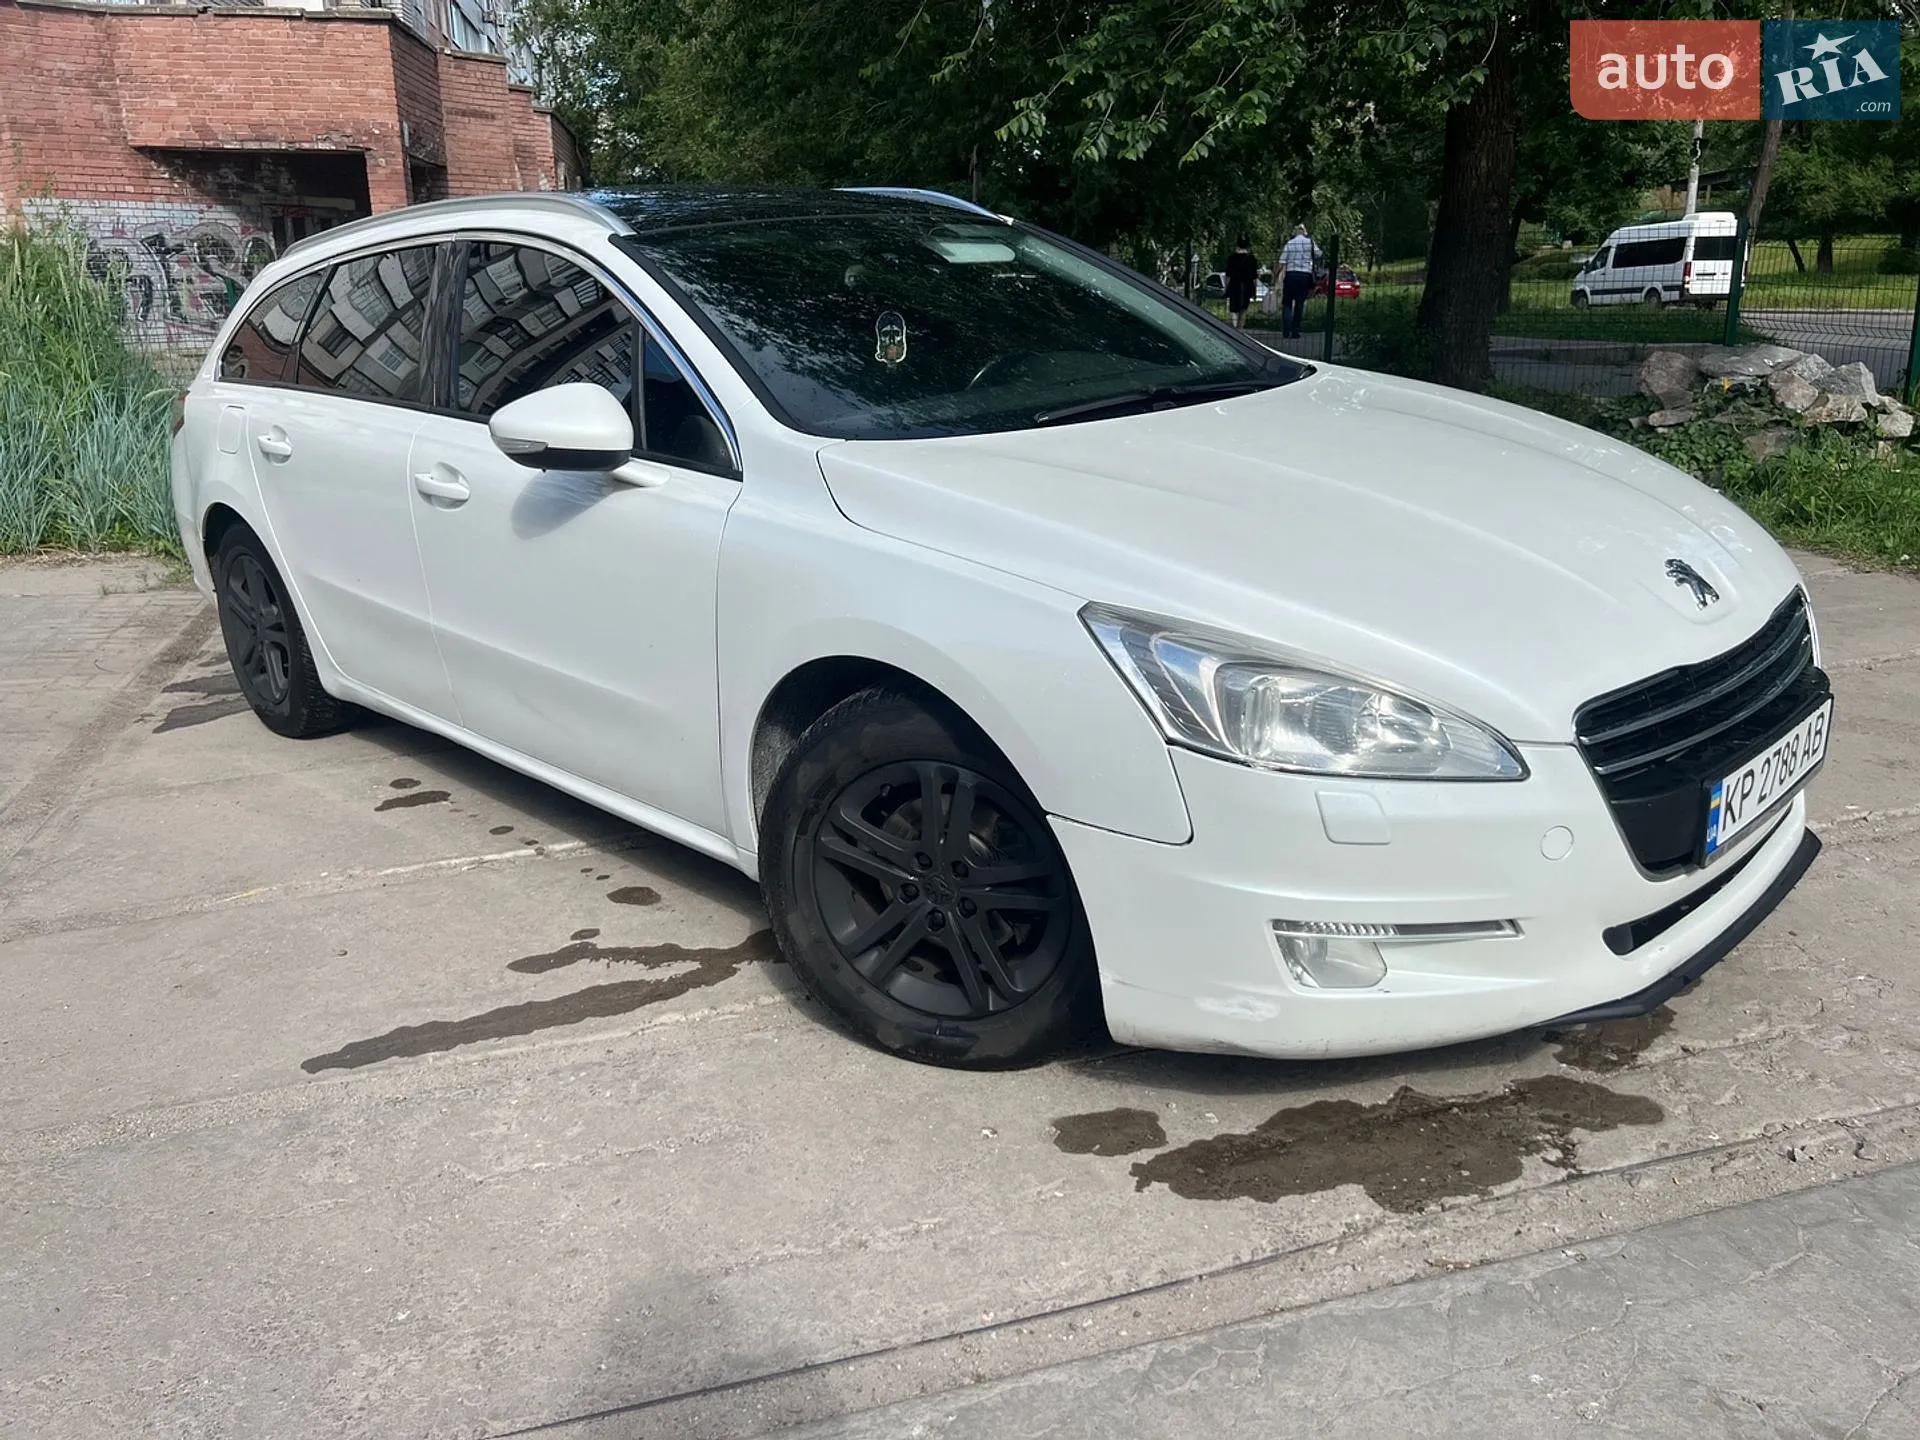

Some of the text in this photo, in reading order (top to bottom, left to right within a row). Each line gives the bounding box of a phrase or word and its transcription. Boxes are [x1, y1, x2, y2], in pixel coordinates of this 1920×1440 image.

[1722, 711, 1825, 832] KP 2788 AB
